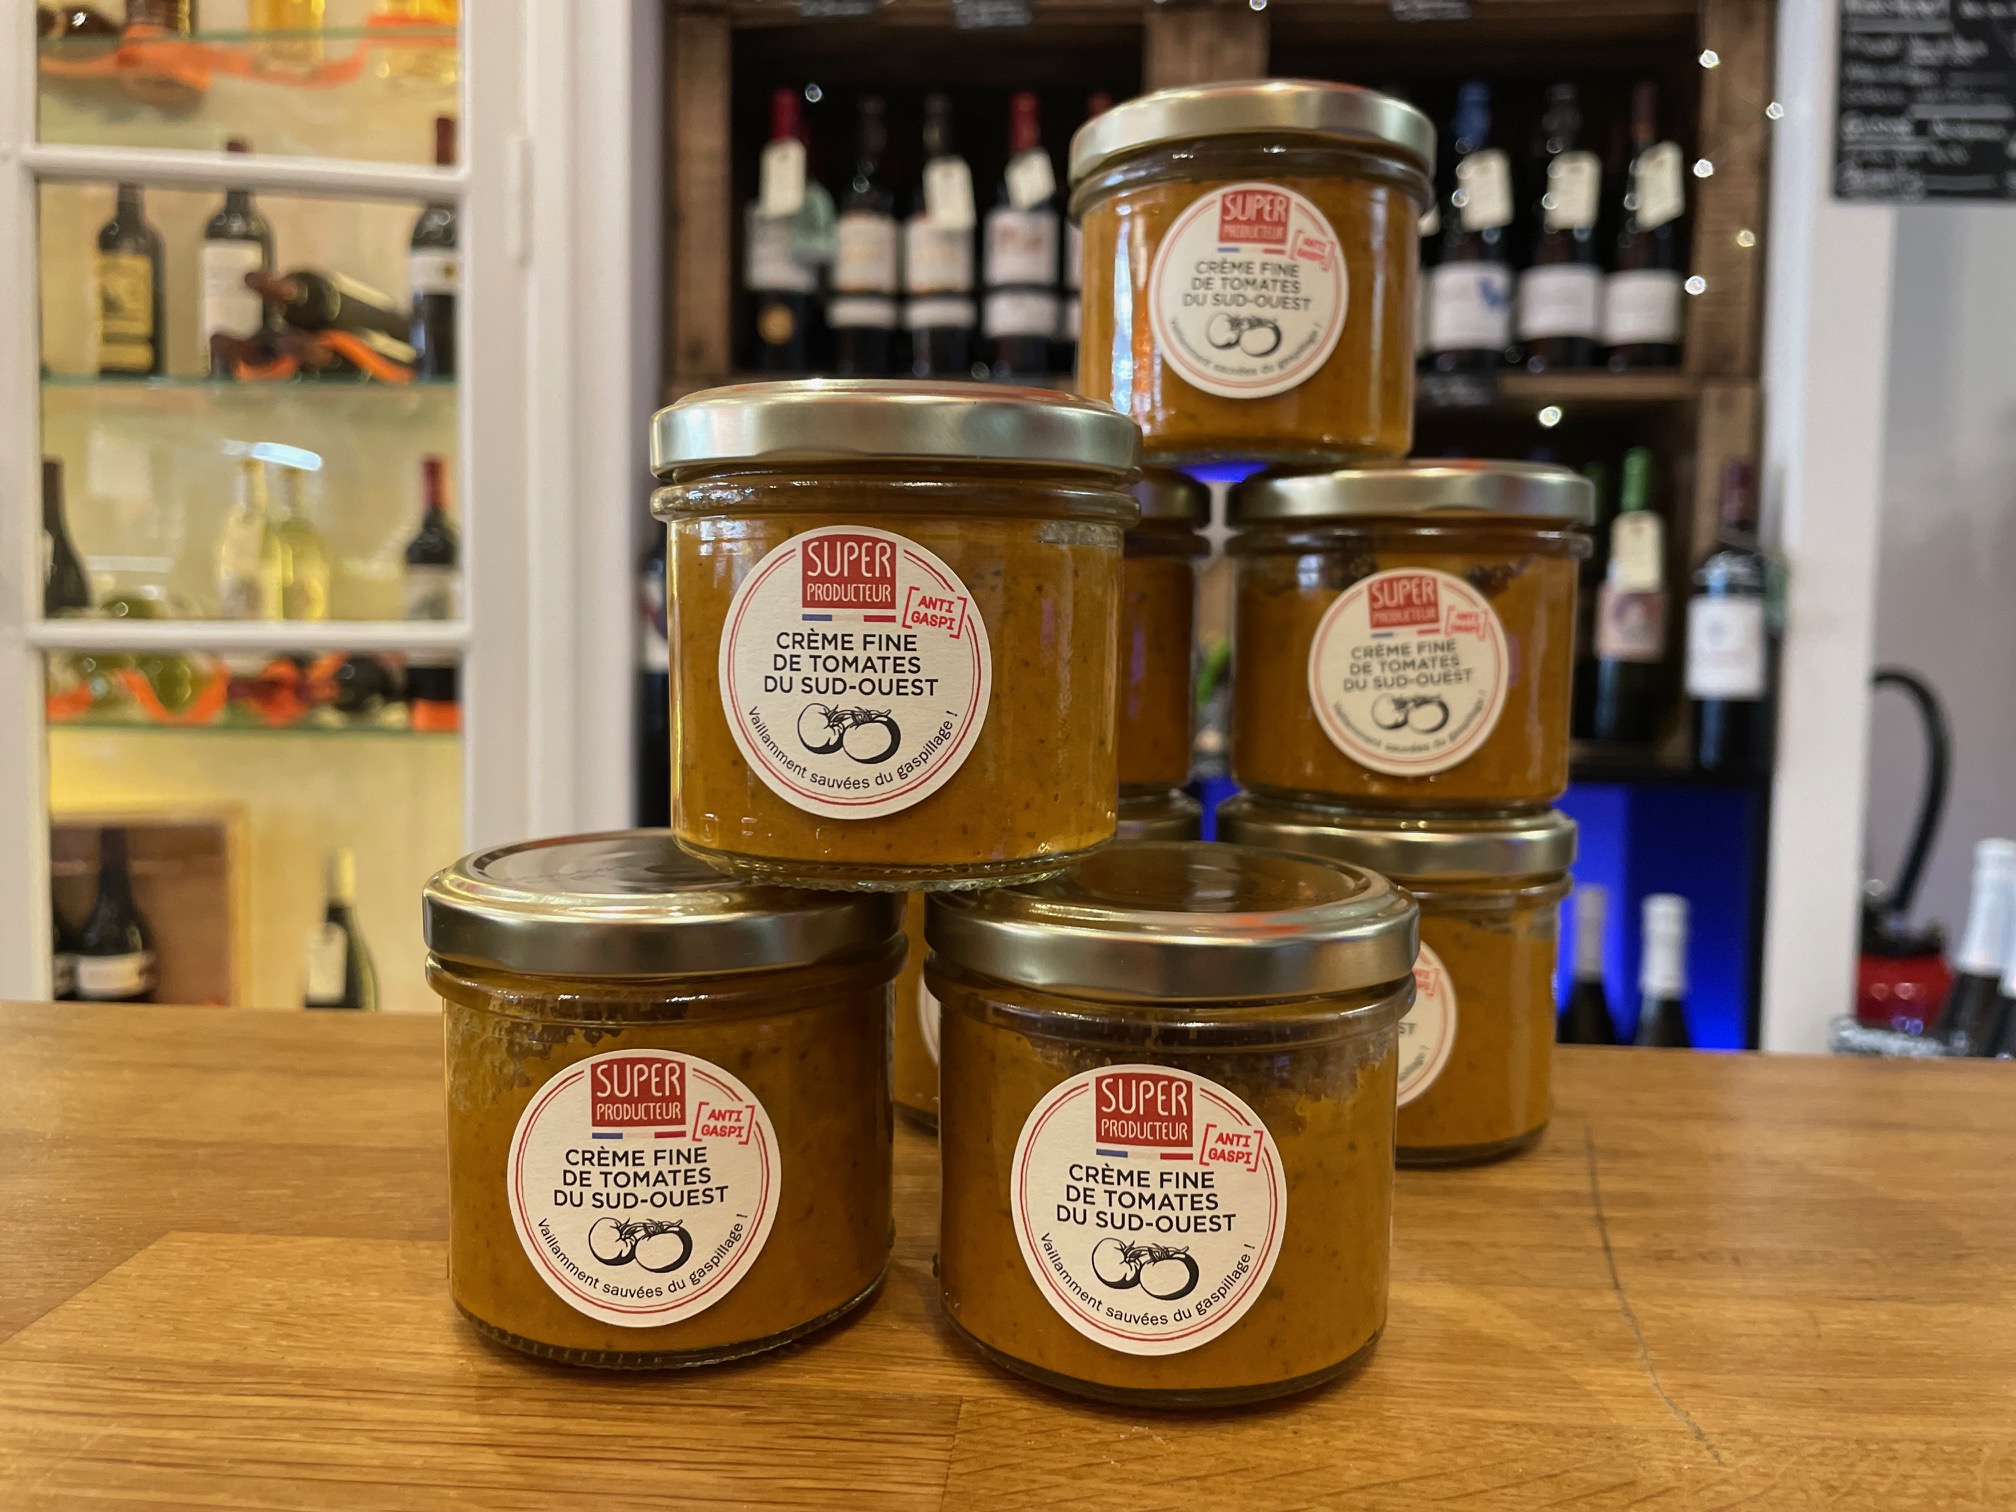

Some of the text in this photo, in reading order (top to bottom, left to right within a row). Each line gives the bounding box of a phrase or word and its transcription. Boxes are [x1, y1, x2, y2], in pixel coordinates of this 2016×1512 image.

[1223, 194, 1287, 223] SUPER
[1260, 264, 1300, 278] FINE
[1191, 277, 1301, 294] DE TOMATES
[1183, 294, 1312, 311] DU SUD-OUEST
[806, 541, 892, 578] SUPER
[807, 583, 891, 603] PRODUCTEUR
[1371, 576, 1436, 609] SUPER
[918, 596, 954, 613] ANTI
[911, 610, 956, 630] GASPI
[776, 628, 918, 652] CRÈME FINE
[1417, 639, 1457, 654] FINE
[773, 654, 921, 674] DE TOMATES
[1350, 655, 1460, 676] DE TOMATES
[764, 676, 939, 697] DU SUD-OUEST
[1343, 668, 1473, 692] DU SUD-OUEST
[749, 706, 807, 778] Vaillamment
[810, 773, 870, 790] sauvées
[875, 773, 893, 786] du
[897, 720, 954, 780] gaspillage
[597, 1062, 681, 1098] SUPER
[1100, 1078, 1188, 1116] SUPER
[597, 1102, 682, 1121] PRODUCTEUR
[707, 1109, 743, 1123] ANTI
[701, 1124, 745, 1138] GASPI
[1101, 1119, 1188, 1141] PRODUCTEUR
[1215, 1132, 1251, 1148] ANTI
[565, 1146, 707, 1167] CRÈME FINE
[1208, 1148, 1252, 1165] GASPI
[563, 1167, 711, 1188] DE TOMATES
[1069, 1163, 1215, 1189] CRÈME FINE
[554, 1186, 728, 1210] DU SUD-OUEST
[1066, 1185, 1219, 1211] DE TOMATES
[1057, 1204, 1236, 1232] DU SUD-OUEST
[538, 1217, 599, 1289] Vaillamment
[602, 1282, 663, 1299] sauvées
[667, 1279, 686, 1294] du
[689, 1225, 743, 1286] gaspillage
[1041, 1232, 1103, 1312] Vaillamment
[1106, 1306, 1168, 1326] sauvées
[1174, 1308, 1192, 1322] du
[1195, 1254, 1251, 1316] gaspillage
